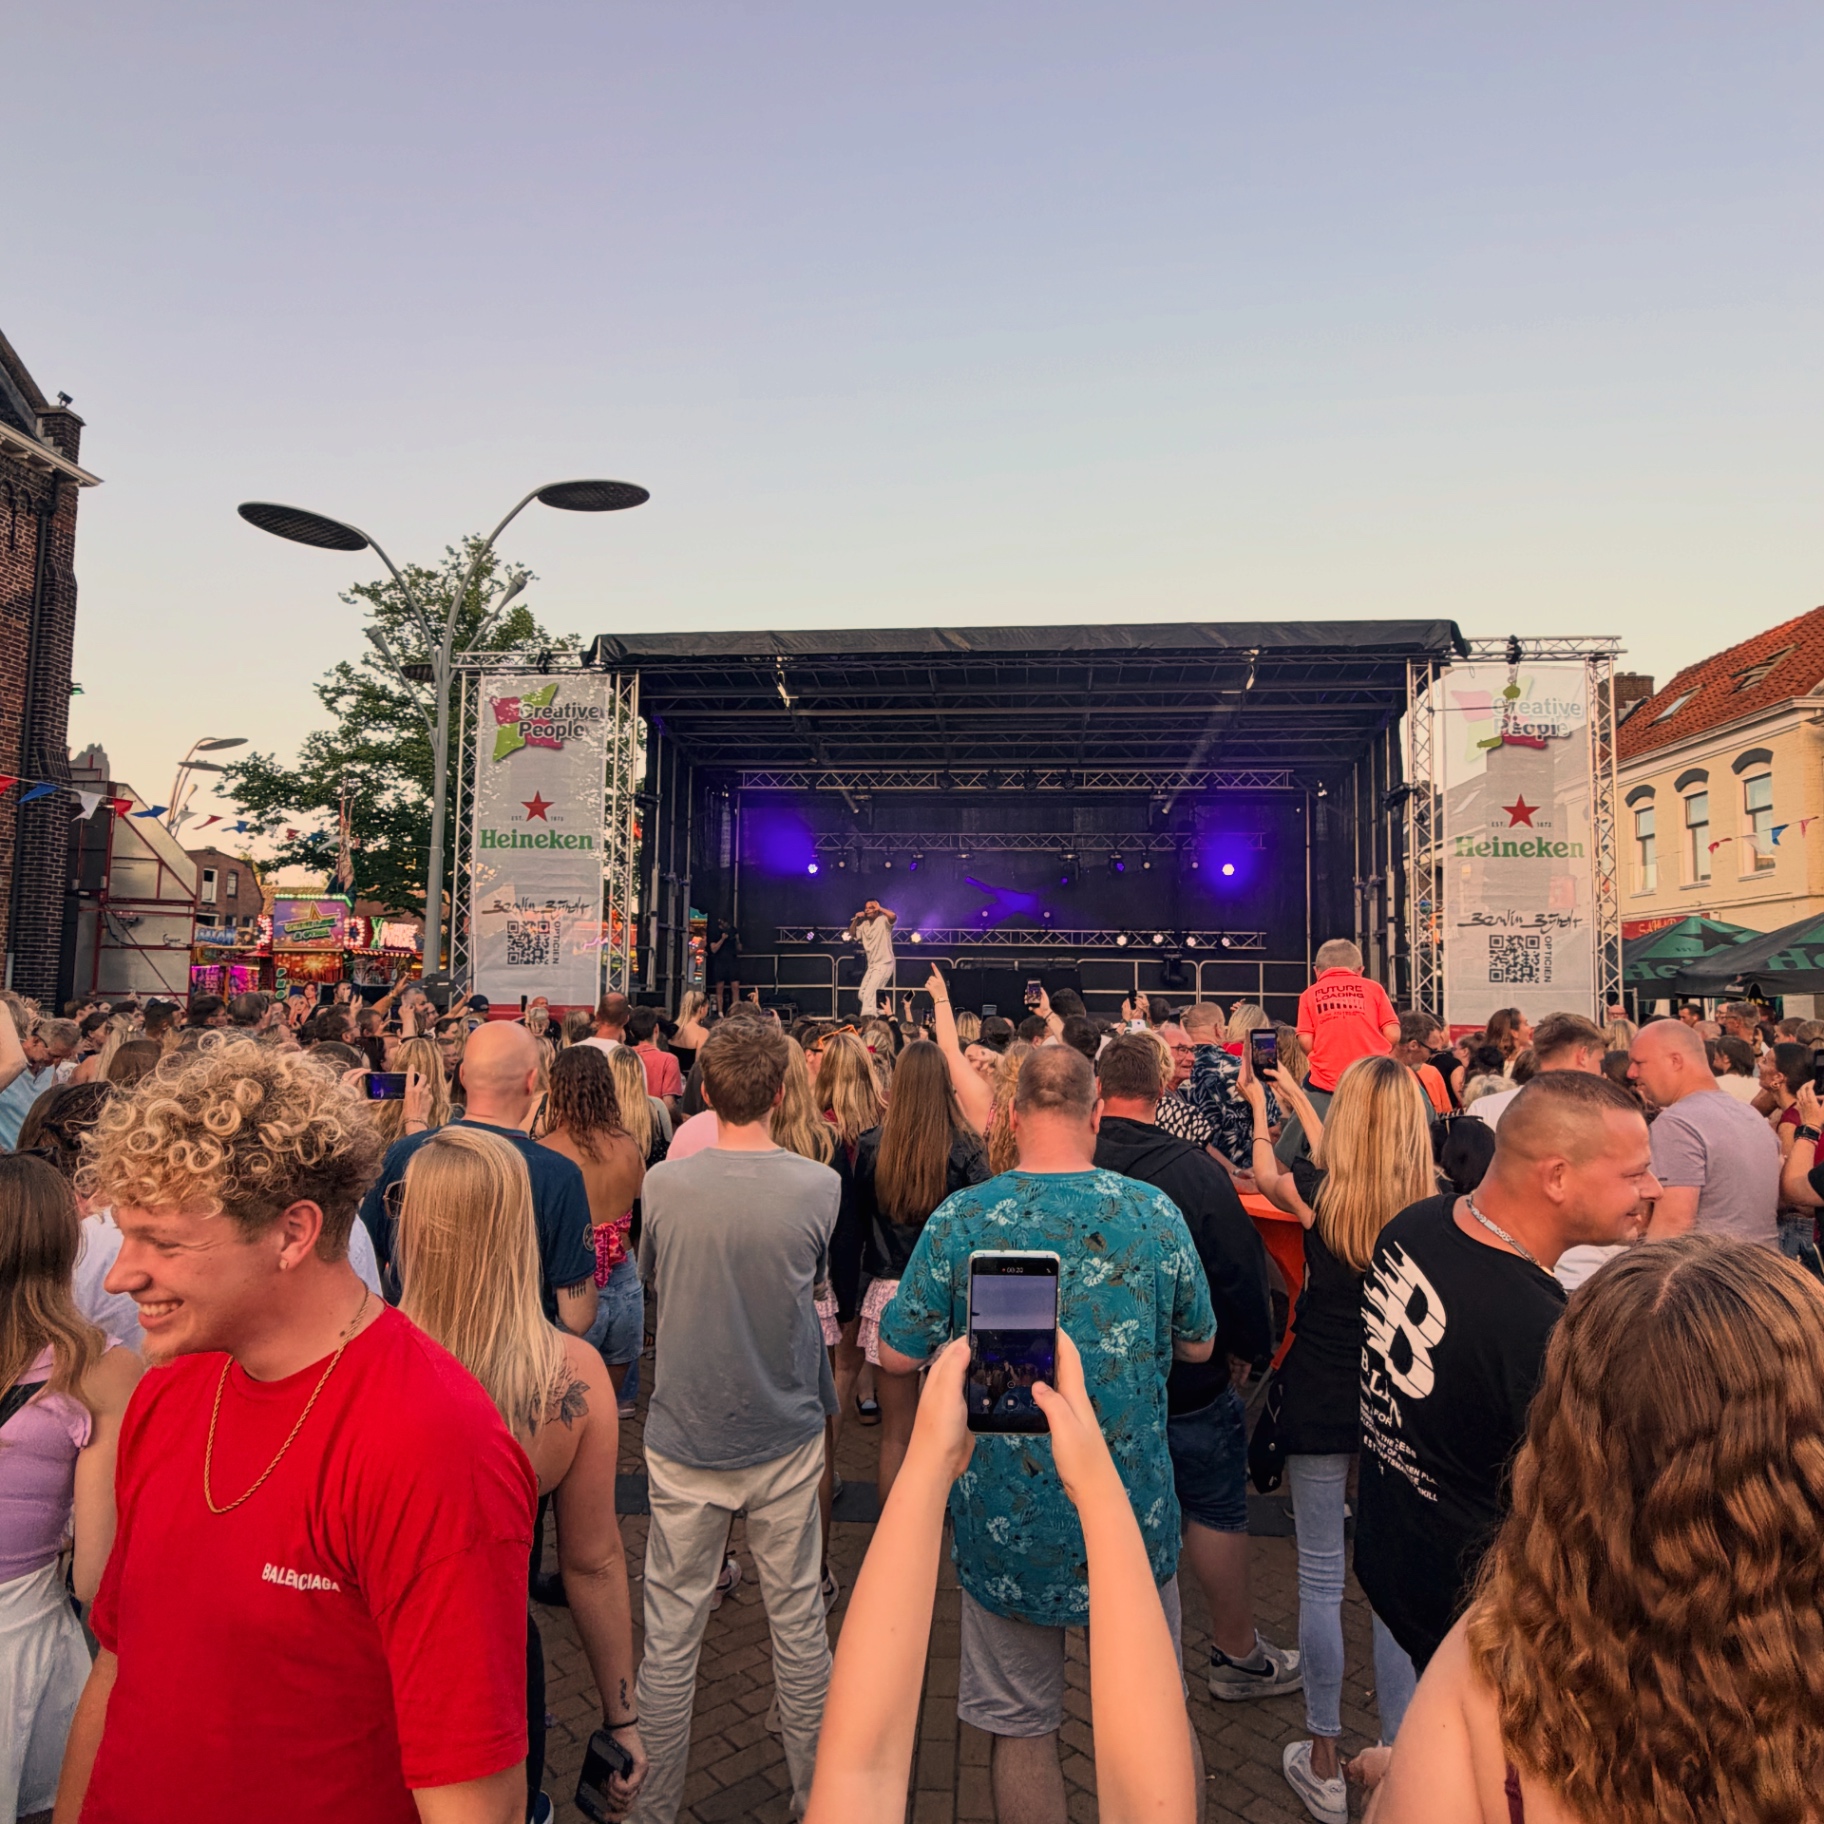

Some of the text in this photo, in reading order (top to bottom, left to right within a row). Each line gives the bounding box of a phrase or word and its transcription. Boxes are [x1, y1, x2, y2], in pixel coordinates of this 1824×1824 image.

[519, 701, 599, 719] Creative
[1493, 697, 1582, 716] Creative
[518, 721, 585, 741] People
[1494, 716, 1570, 740] People
[479, 828, 594, 850] Heineken
[1454, 835, 1585, 858] Heineken
[552, 920, 561, 965] OPTICIEN
[1544, 935, 1552, 983] OPTICIEN
[1315, 984, 1363, 997] FUTURE
[1315, 992, 1365, 1003] LOADING
